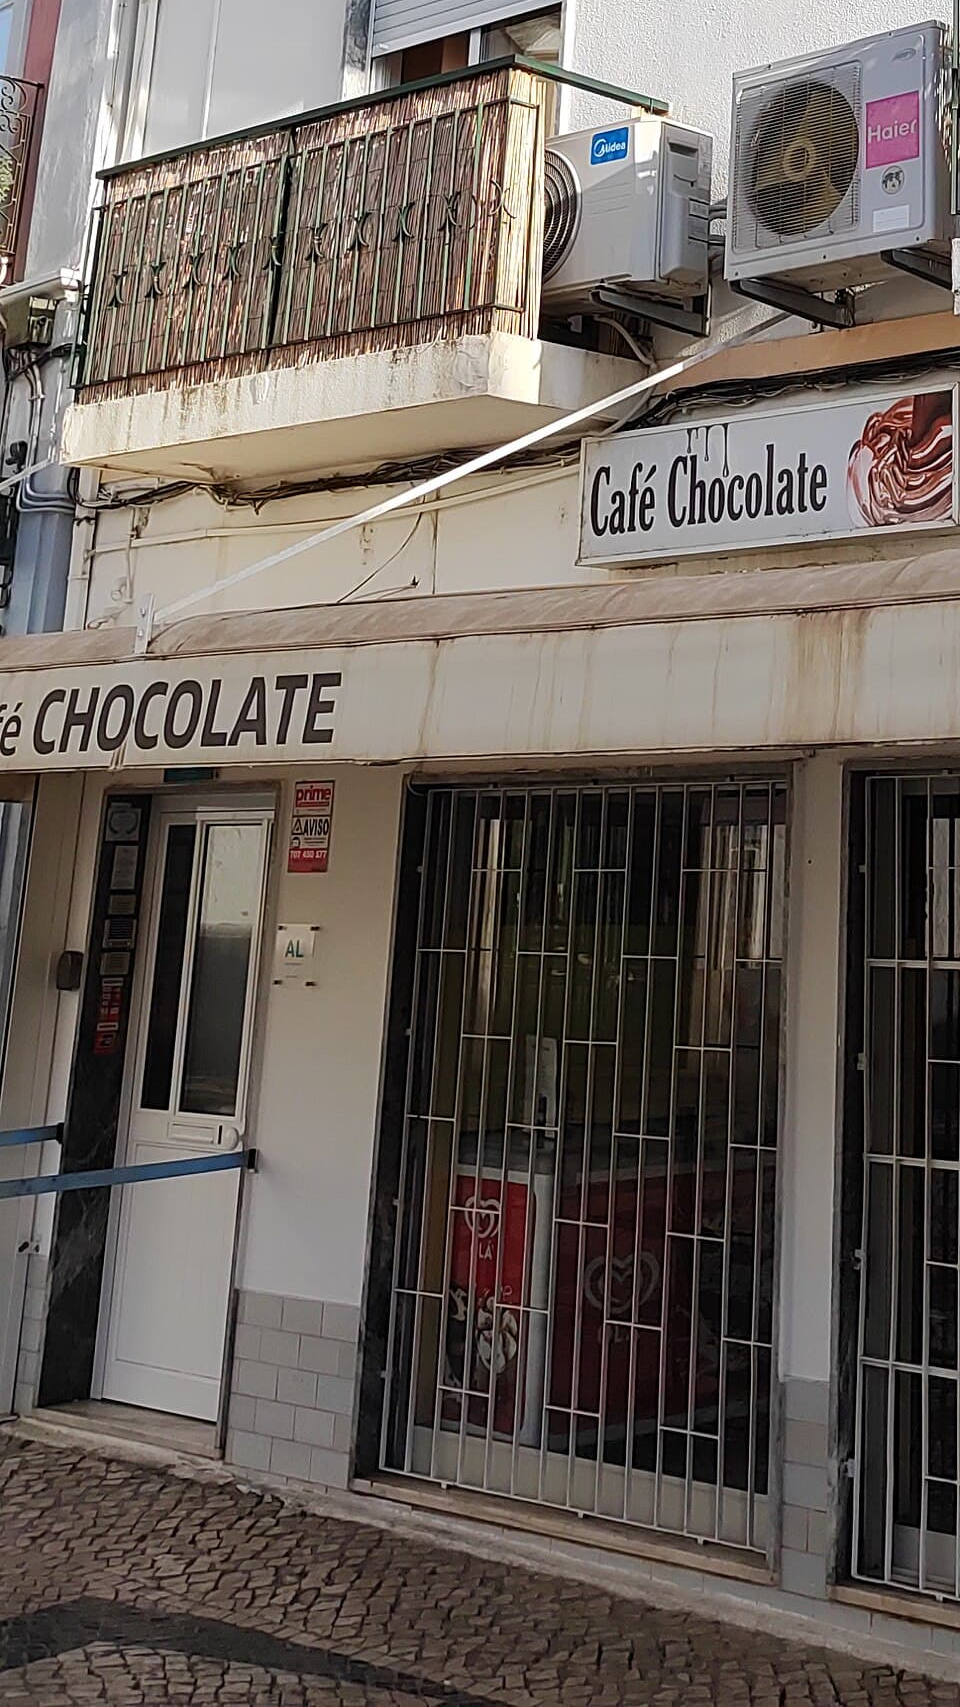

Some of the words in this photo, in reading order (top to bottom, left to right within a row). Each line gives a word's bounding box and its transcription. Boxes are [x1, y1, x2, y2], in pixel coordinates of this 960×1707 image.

[867, 119, 918, 144] Haier
[593, 138, 626, 157] Midea
[590, 462, 657, 537] Café
[667, 443, 828, 528] Chocolate
[32, 672, 342, 755] CHOCOLATE
[296, 785, 332, 803] prime
[302, 818, 330, 836] AVISO
[284, 939, 304, 958] AL
